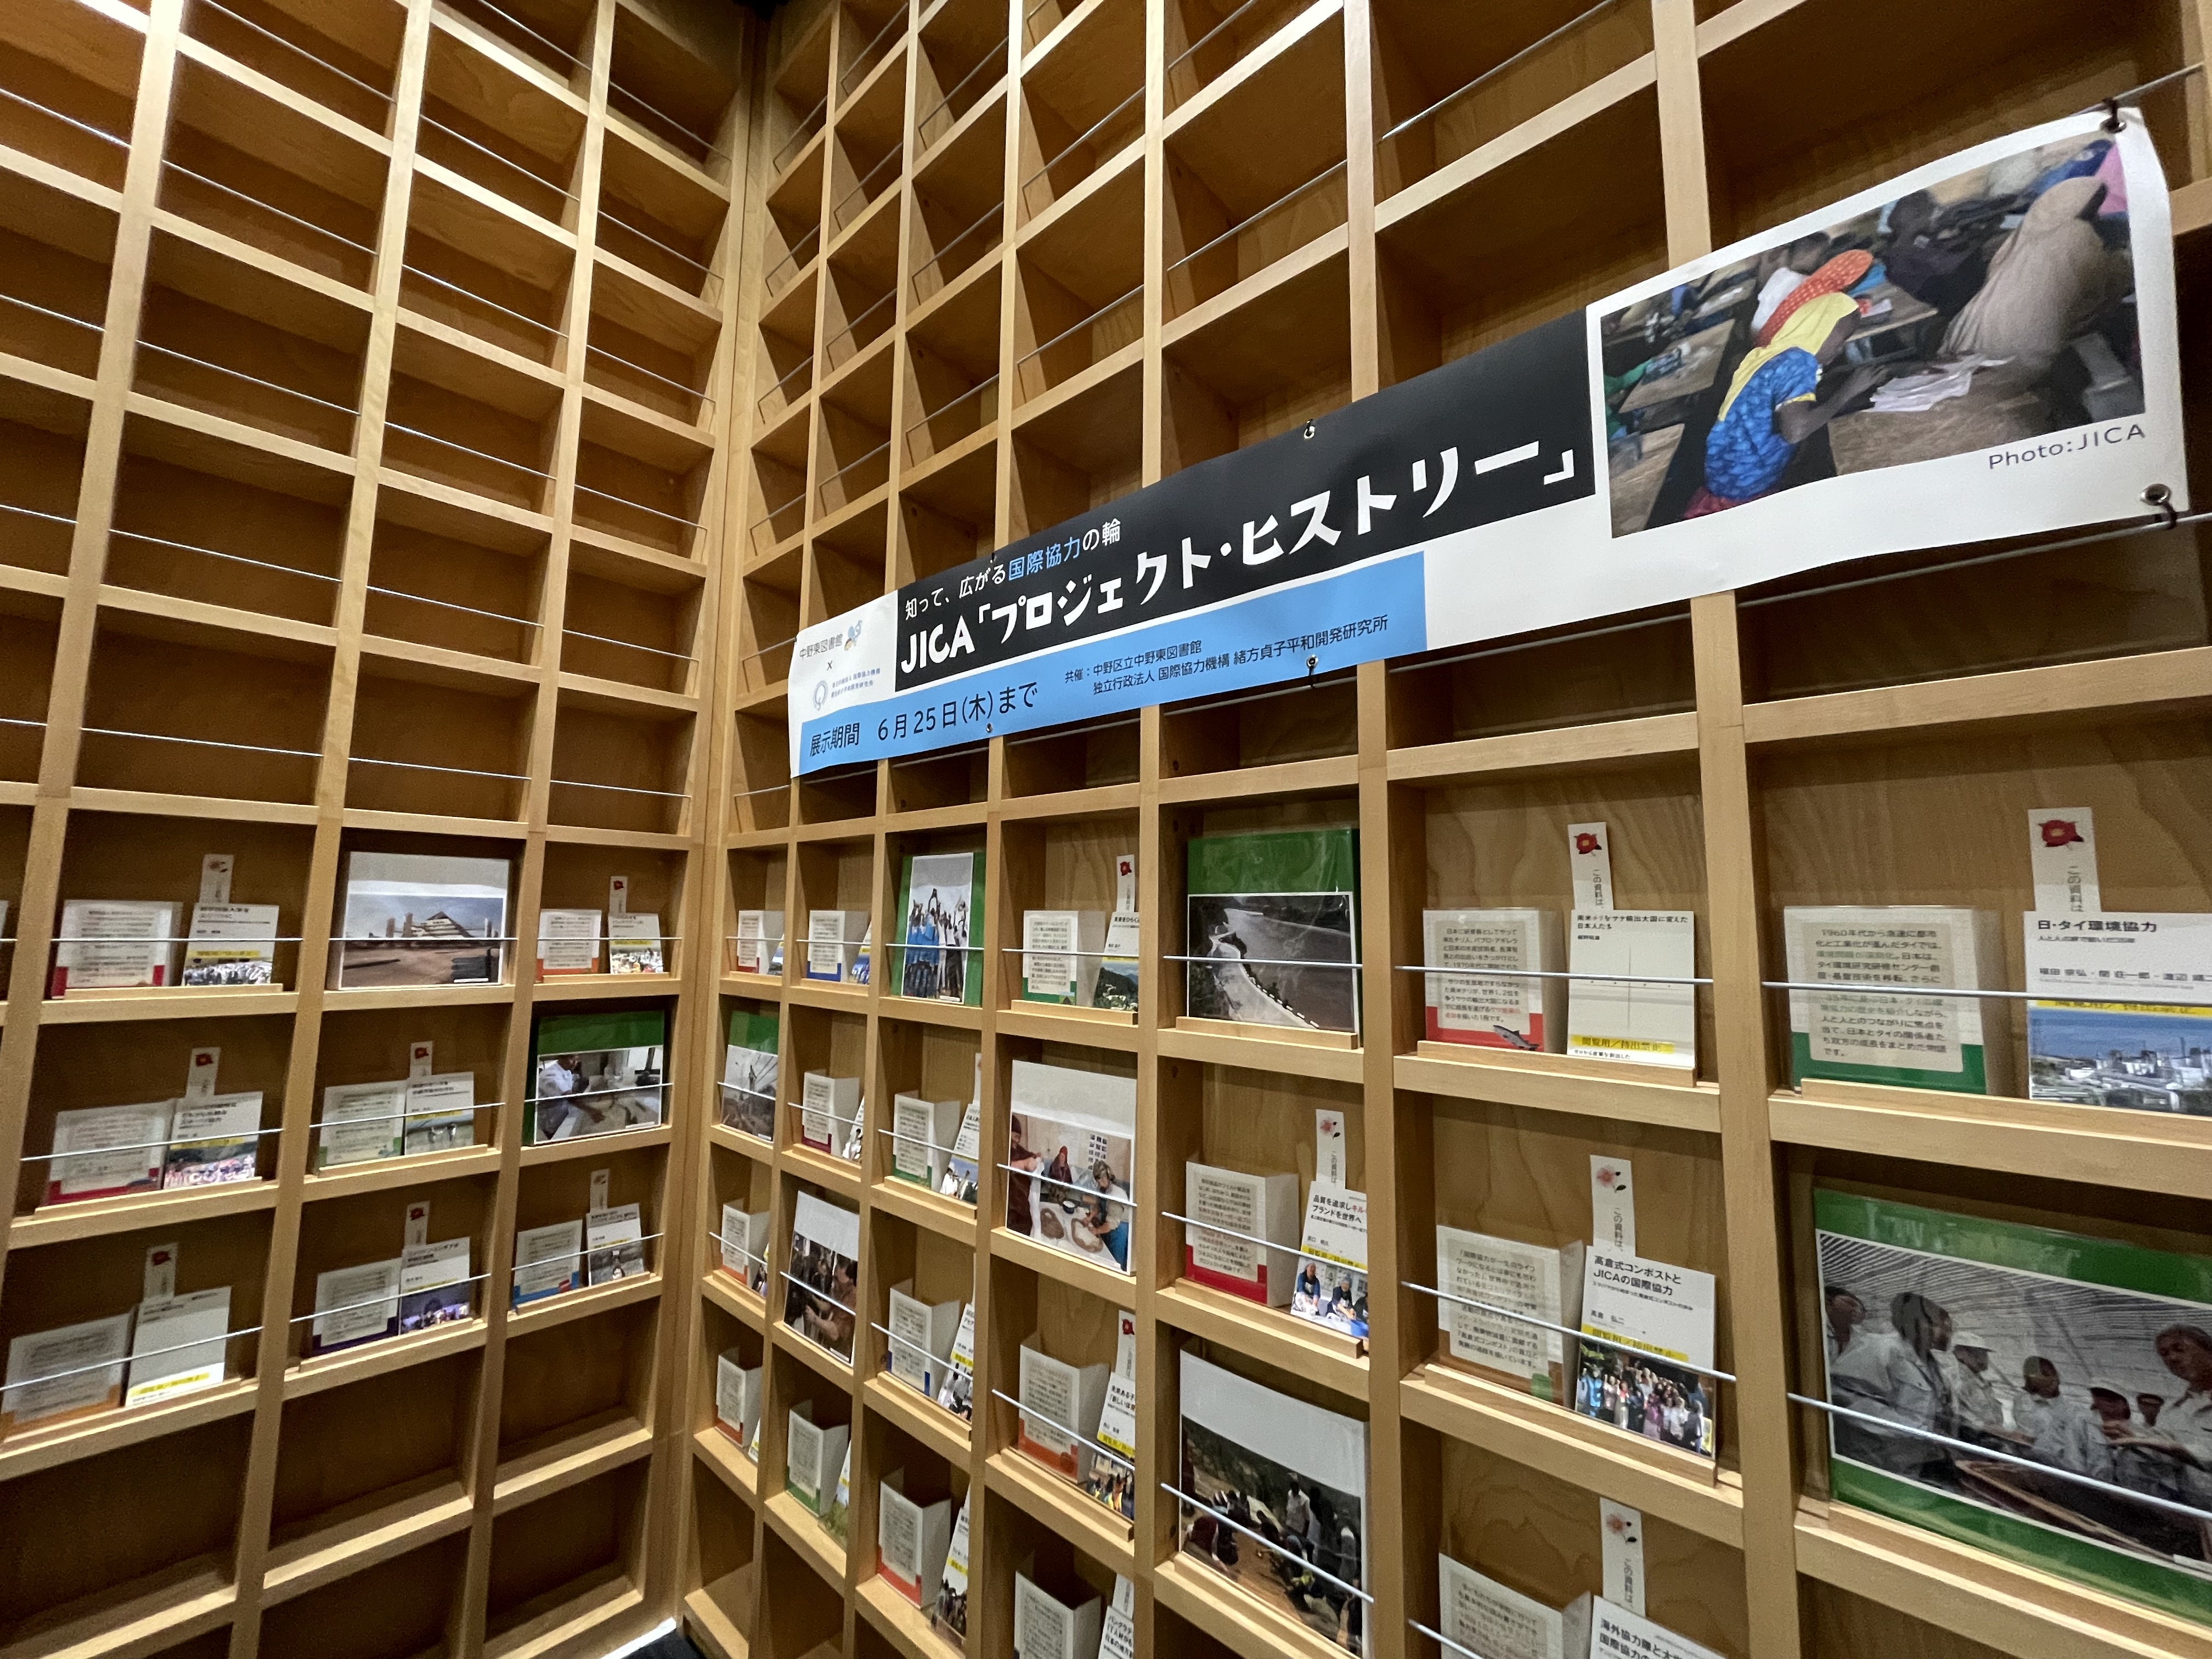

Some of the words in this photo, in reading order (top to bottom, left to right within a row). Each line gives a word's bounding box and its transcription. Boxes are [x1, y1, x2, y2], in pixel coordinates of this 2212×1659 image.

[1988, 424, 2146, 470] Photo:JICA
[900, 440, 1576, 674] JICA「プロジェクト・ヒストリー」
[904, 517, 1121, 620] 知って、広がる国際協力の輪
[1093, 672, 1155, 695] 独立行政法人
[1158, 652, 1230, 681] 国際協力機構
[1233, 614, 1389, 665] 緒方貞子平和開発研究所
[809, 722, 860, 758] 展示期間
[2038, 920, 2157, 932] 日・タイ環境協力
[1593, 1269, 1673, 1296] JICAの国際協力
[1594, 1255, 1681, 1285] 高倉式コンポストと
